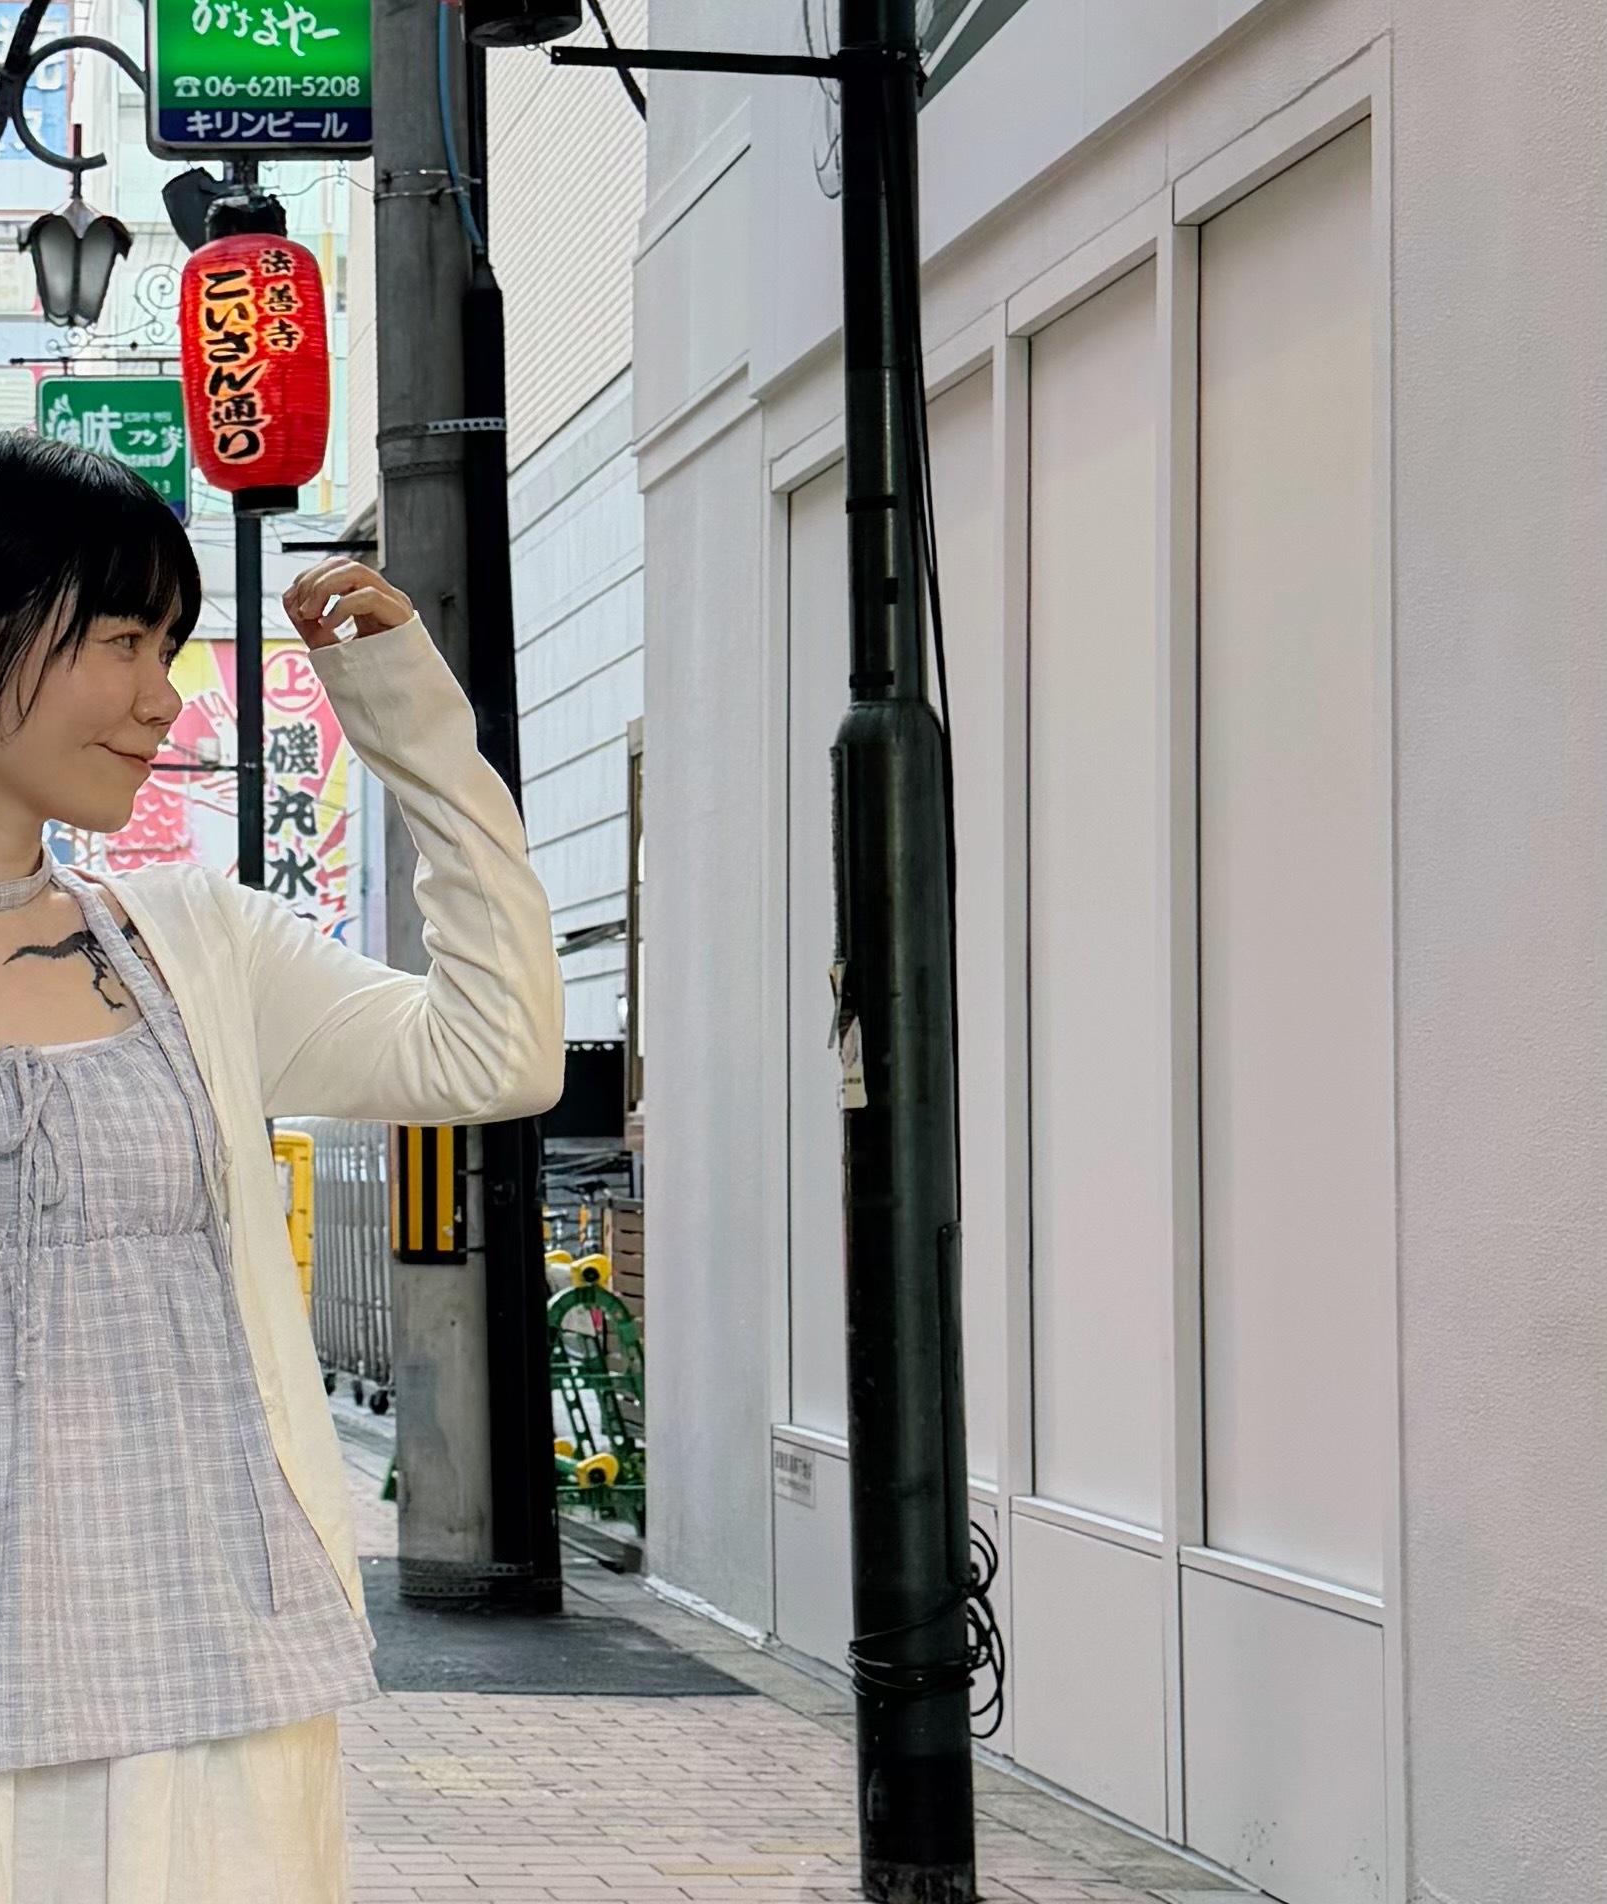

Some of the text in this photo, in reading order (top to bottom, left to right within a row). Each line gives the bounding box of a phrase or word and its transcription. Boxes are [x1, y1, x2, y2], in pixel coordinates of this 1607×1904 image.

[204, 76, 360, 97] 06-6211-5208
[187, 110, 349, 139] キリンビール
[258, 249, 301, 351] 法善寺
[201, 267, 270, 462] こいさん通り
[271, 657, 315, 699] 上
[267, 721, 319, 922] 磯丸水
